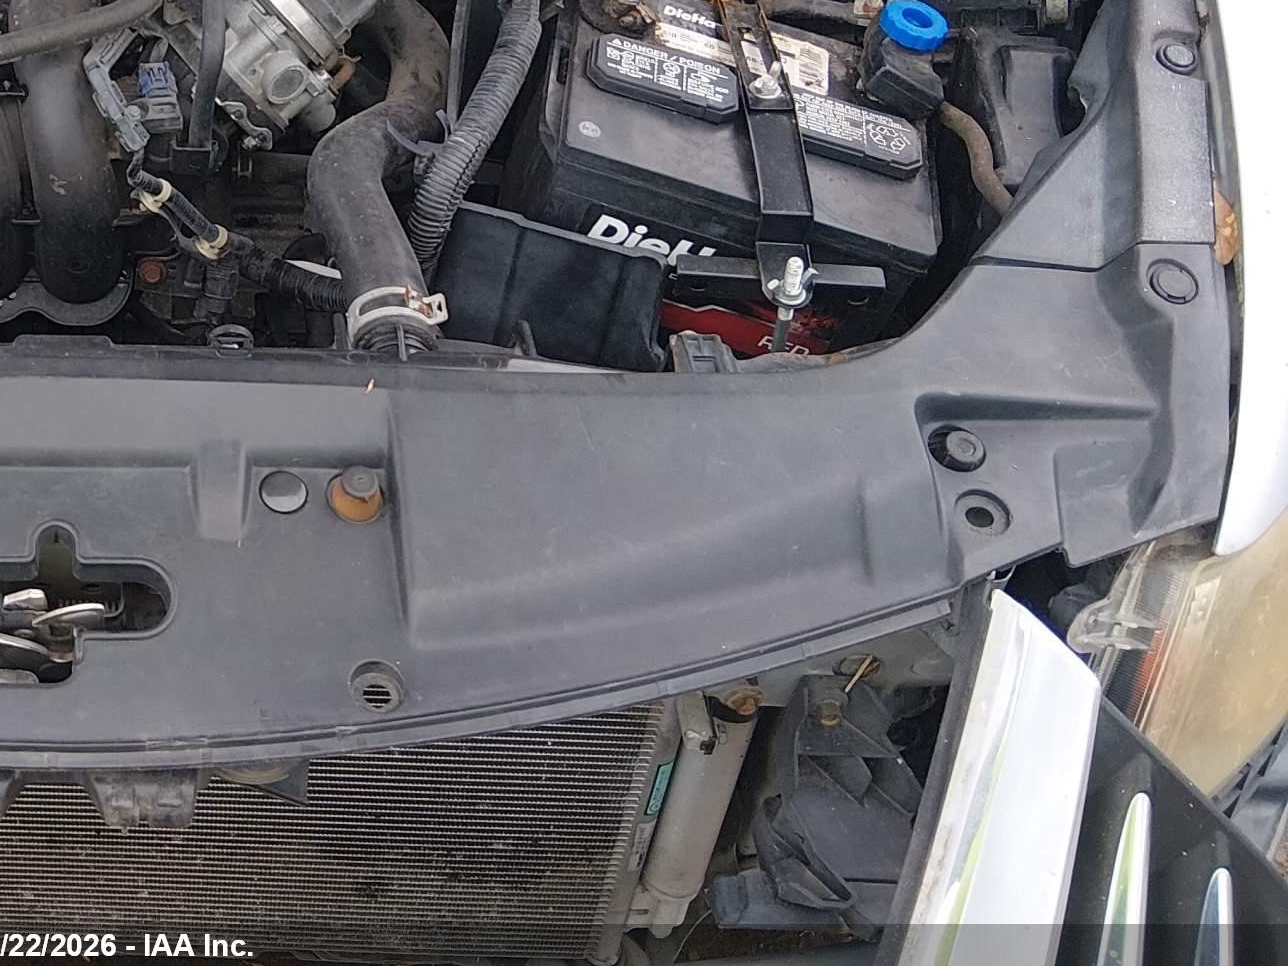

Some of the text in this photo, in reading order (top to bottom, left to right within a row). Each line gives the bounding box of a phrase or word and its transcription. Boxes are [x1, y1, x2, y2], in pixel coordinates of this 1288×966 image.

[663, 5, 720, 29] DieHa
[623, 41, 669, 61] DANGER
[680, 57, 721, 74] POISON
[587, 214, 717, 267] DieH
